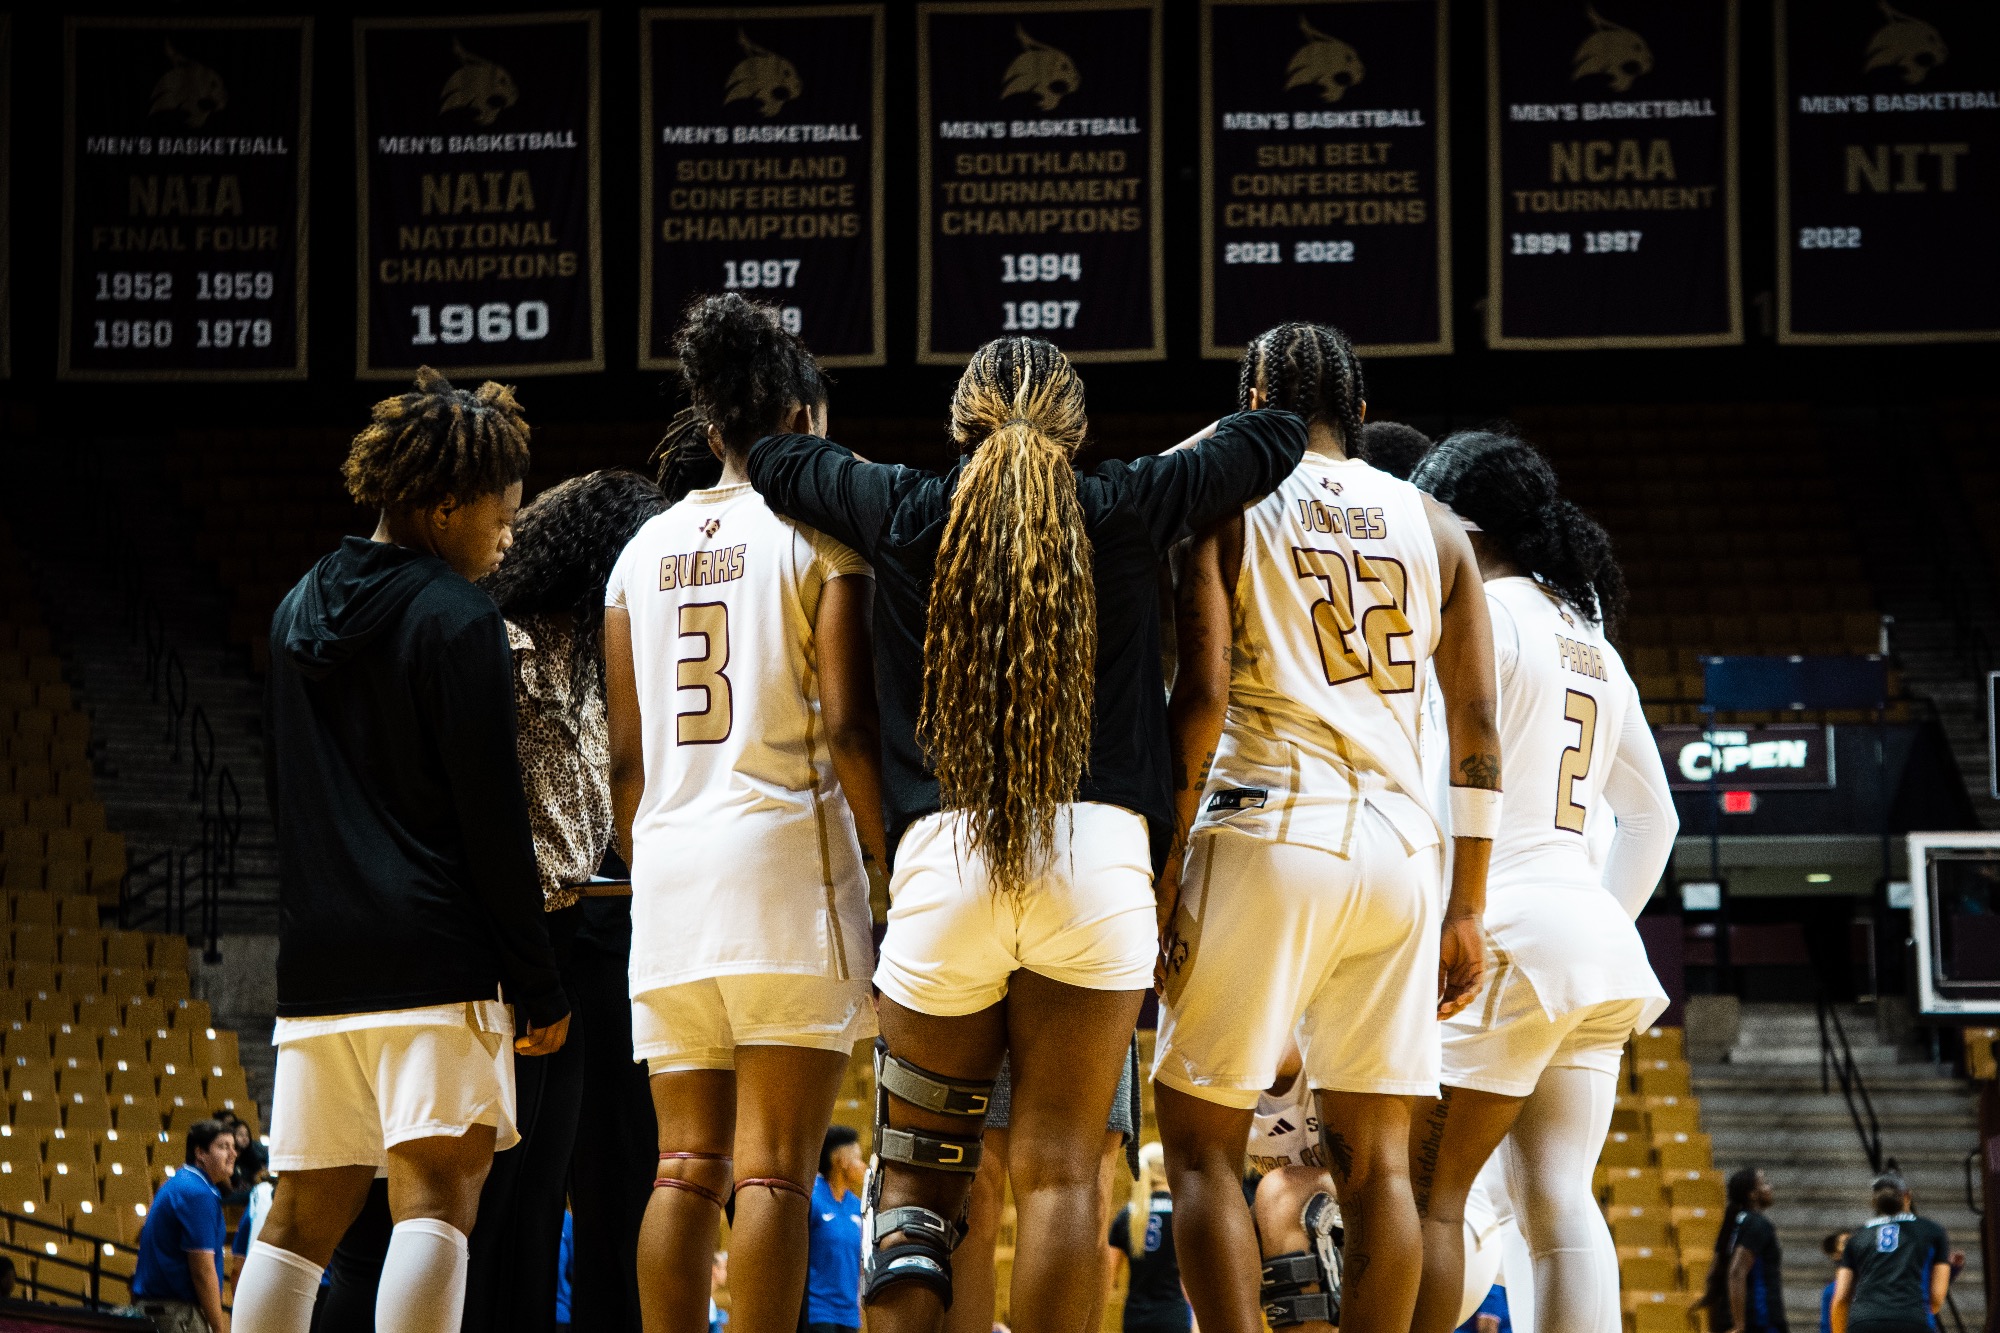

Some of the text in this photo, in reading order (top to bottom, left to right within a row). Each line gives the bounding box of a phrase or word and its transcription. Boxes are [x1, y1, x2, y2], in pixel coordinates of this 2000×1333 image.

[1509, 98, 1716, 122] MEN'S BASKETBALL
[1799, 94, 1870, 114] MEN'S
[662, 123, 862, 145] MEN'S BASKETBALL
[939, 117, 1141, 140] MEN'S BASKETBALL
[1222, 109, 1425, 131] MEN'S BASKETBALL
[86, 135, 289, 156] MEN'S BASKETBALL
[378, 129, 578, 155] MEN'S BASKETBALL
[1256, 141, 1392, 168] SUN BELT
[676, 155, 847, 182] SOUTHLAND
[955, 149, 1127, 176] SOUTHLAND
[1550, 138, 1676, 183] NCAA
[1844, 142, 1969, 195] NIT
[129, 174, 244, 218] NAIA
[421, 170, 536, 216] NAIA
[669, 183, 855, 211] CONFERENCE
[941, 177, 1141, 204] TOURNAMENT
[1231, 170, 1419, 197] CONFERENCE
[1223, 199, 1427, 228] CHAMPIONS
[1512, 186, 1714, 214] TOURNAMENT
[399, 220, 558, 250] NATIONAL
[662, 212, 860, 242] CHAMPIONS
[940, 206, 1142, 236] CHAMPIONS
[92, 225, 278, 252] FINAL FOUR
[1224, 240, 1355, 265] 2021 2022
[1511, 230, 1643, 256] 1994 1997
[1798, 226, 1862, 250] 2022
[379, 250, 578, 284] CHAMPIONS
[723, 259, 801, 290] 1997
[1001, 253, 1082, 283] 1994
[95, 271, 274, 301] 1952 1959
[411, 300, 550, 345] 1960
[1002, 300, 1081, 331] 1997
[93, 318, 273, 349] 1960 1979
[1297, 499, 1387, 540] JONES
[659, 543, 747, 592] BURKS
[1291, 546, 1417, 695] 22
[676, 600, 734, 748] 3
[1554, 687, 1598, 837] 2
[1877, 1223, 1900, 1253] 8
